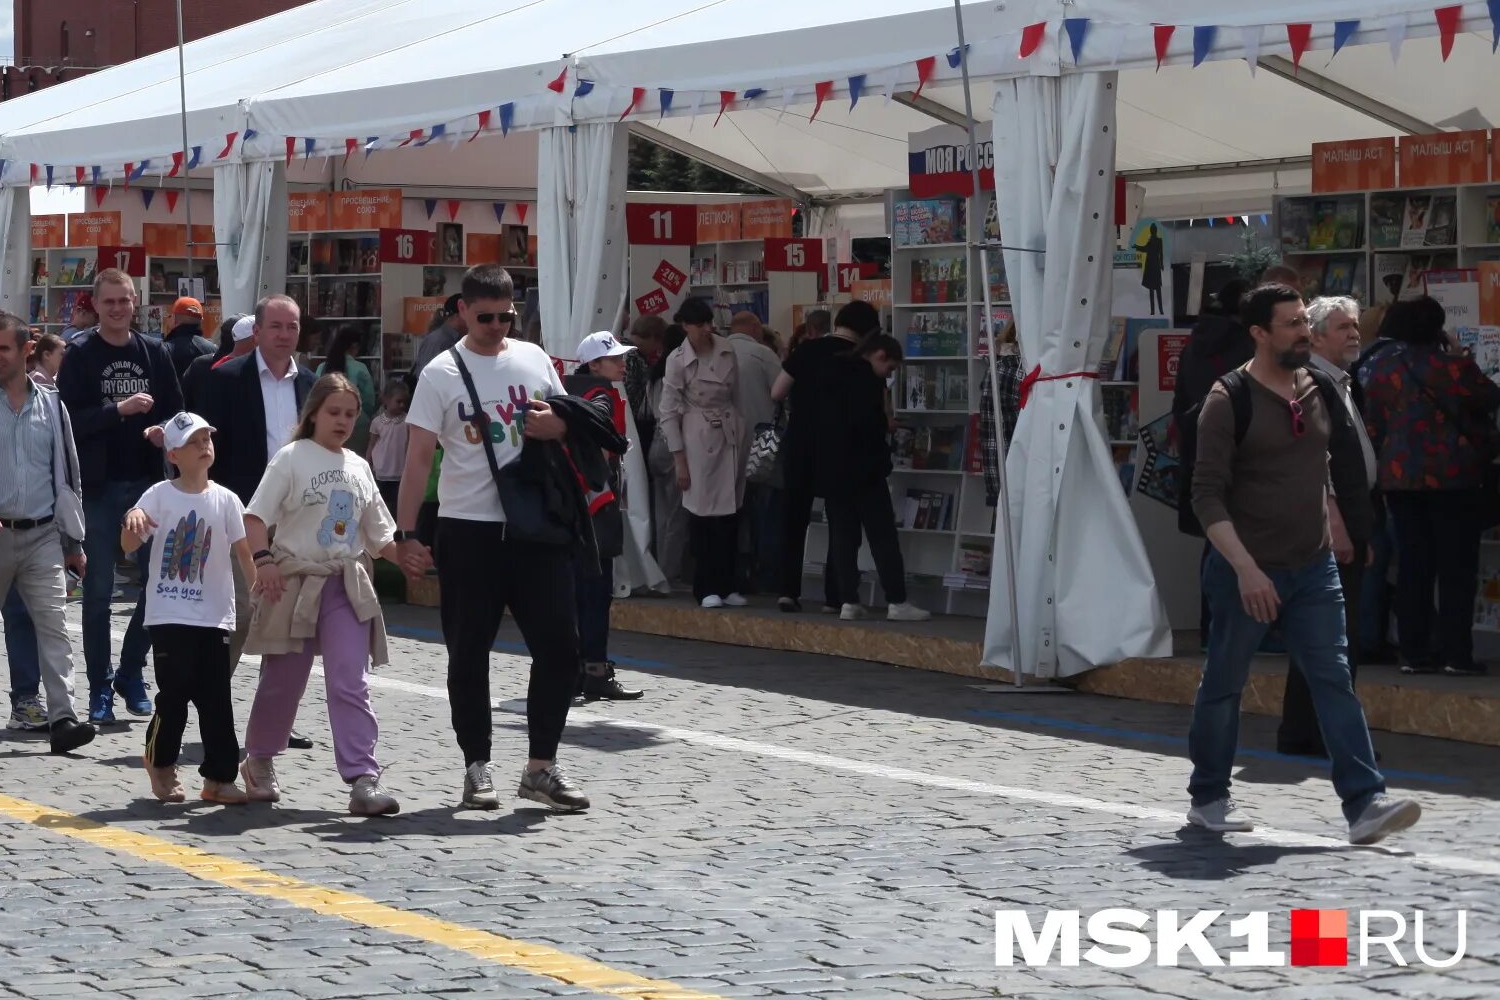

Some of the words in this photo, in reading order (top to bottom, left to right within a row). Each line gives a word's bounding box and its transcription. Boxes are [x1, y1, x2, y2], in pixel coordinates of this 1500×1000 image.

[1323, 150, 1362, 163] МАЛЫШ
[1364, 147, 1385, 160] АСТ
[1410, 142, 1451, 156] МАЛЫШ
[1454, 140, 1476, 154] АСТ
[925, 146, 954, 175] МОЯ
[650, 210, 672, 239] 11
[395, 234, 414, 259] 16
[783, 243, 805, 267] 15
[114, 251, 131, 273] 17
[112, 360, 131, 369] TAILOR
[311, 469, 350, 490] LUCKY
[156, 582, 179, 594] Sea
[181, 587, 202, 599] you
